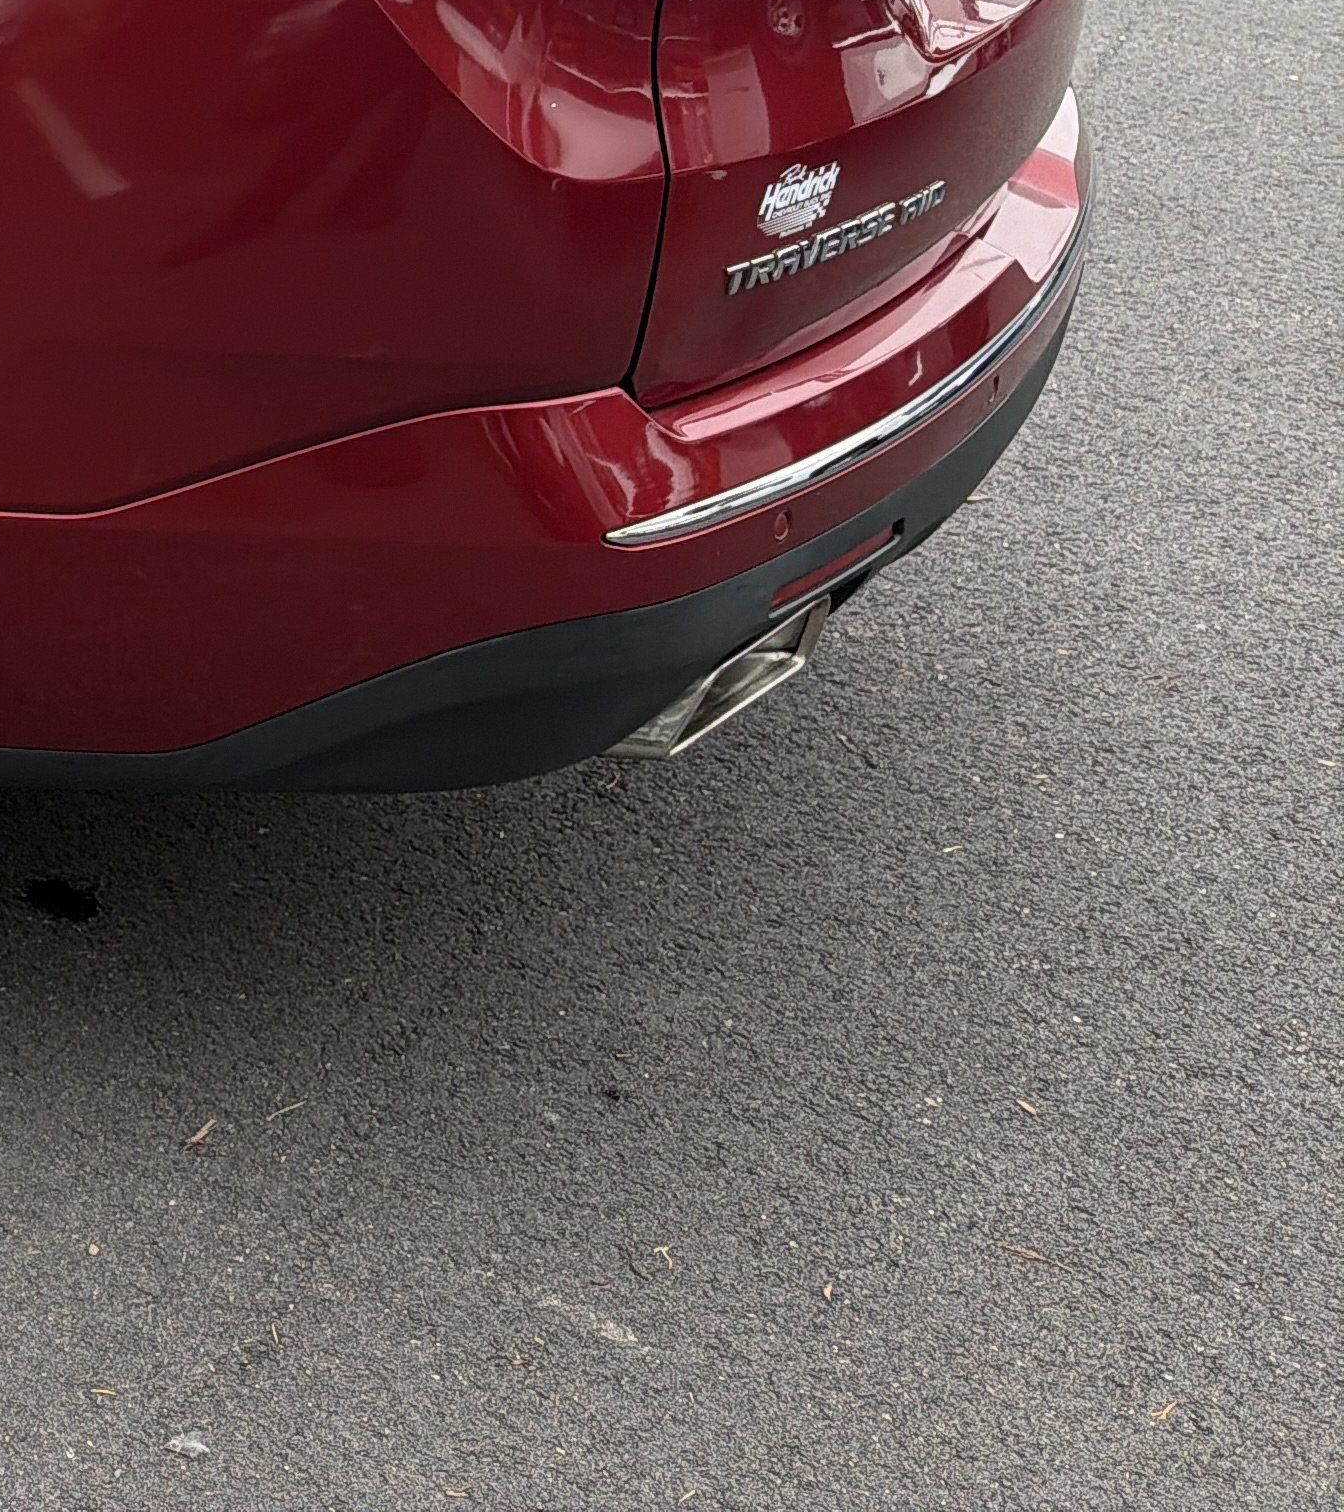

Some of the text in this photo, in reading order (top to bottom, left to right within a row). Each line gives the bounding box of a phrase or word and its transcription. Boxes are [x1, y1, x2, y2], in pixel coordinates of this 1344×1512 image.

[758, 161, 840, 222] Hendrick
[725, 180, 946, 295] TRAVERSE AWD
